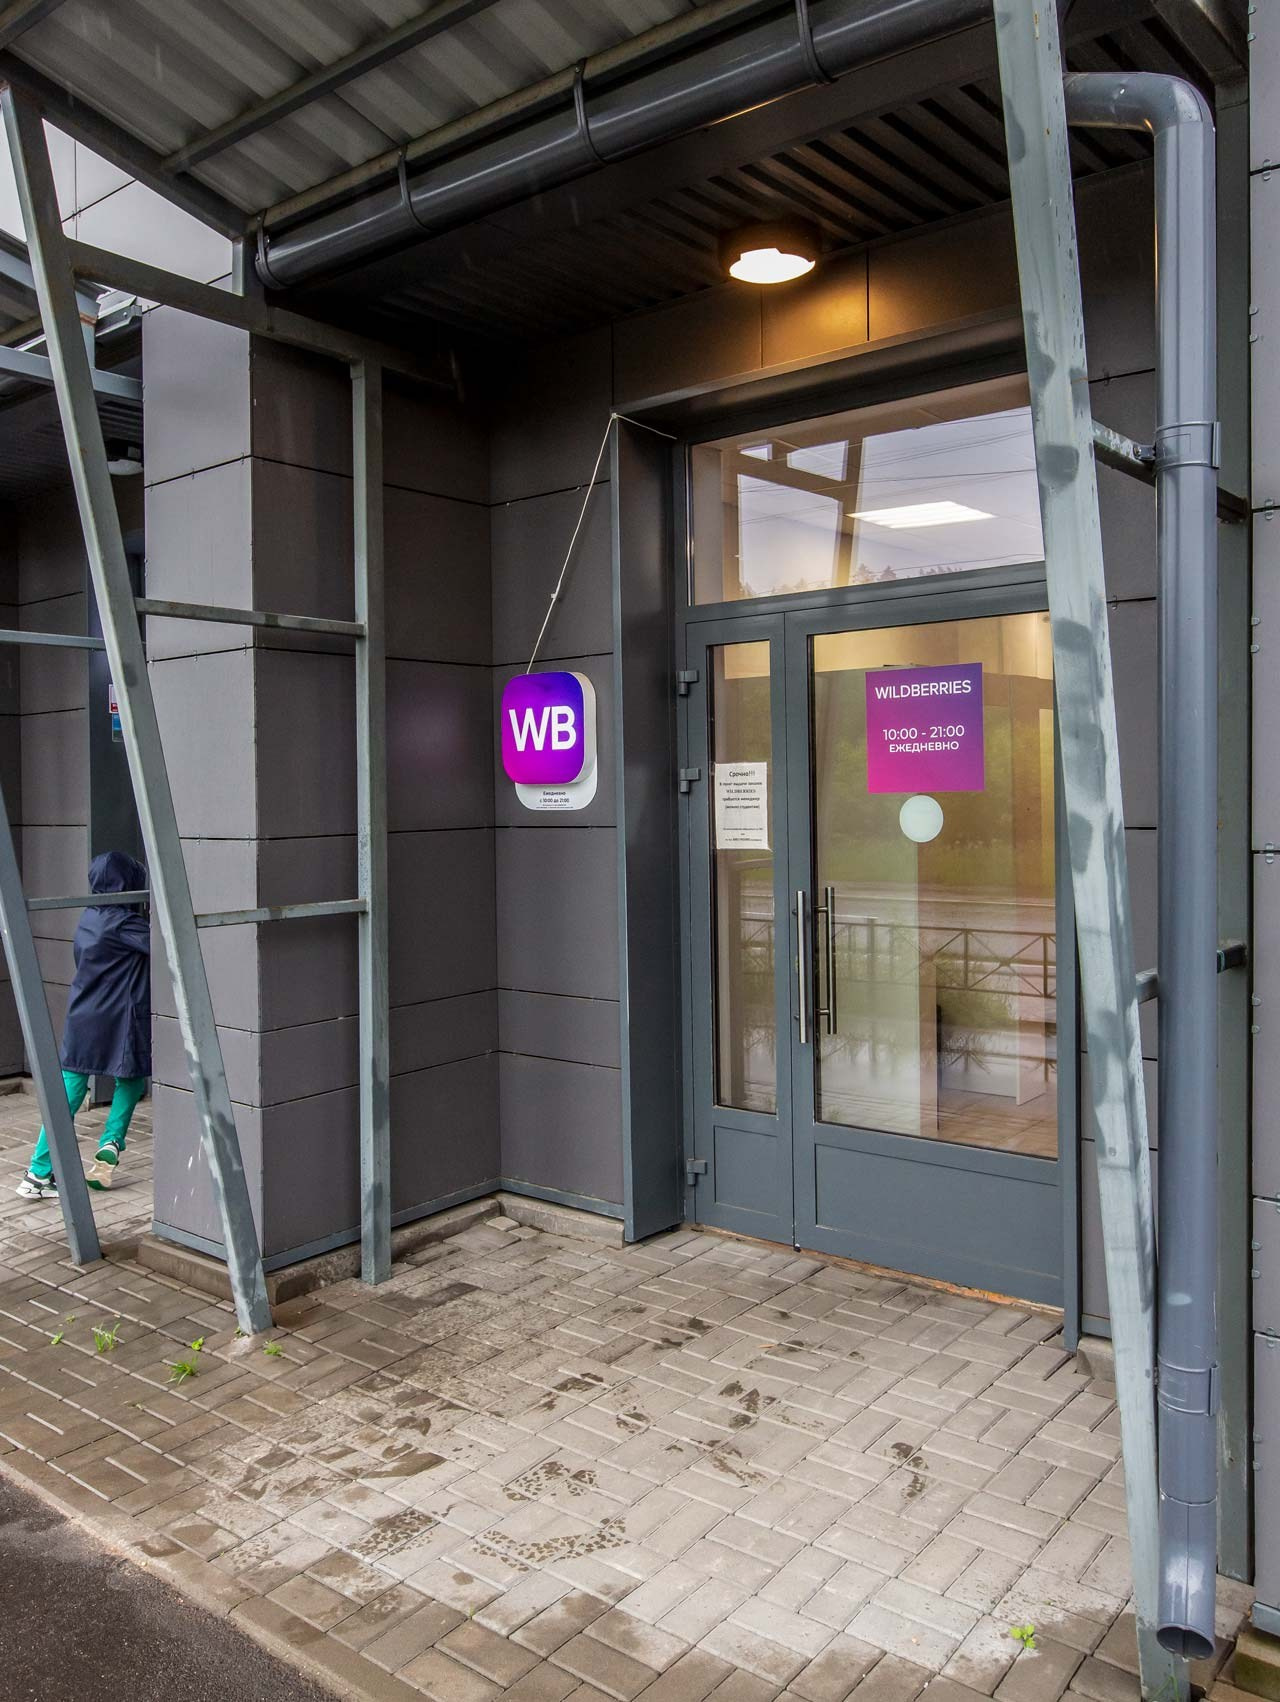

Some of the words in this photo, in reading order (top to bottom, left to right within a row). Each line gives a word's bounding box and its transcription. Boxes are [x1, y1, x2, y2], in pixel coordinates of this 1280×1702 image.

[874, 679, 972, 700] WILDBERRIES
[508, 705, 577, 752] WB
[883, 727, 918, 741] 10:00
[929, 725, 965, 738] 21:00
[889, 741, 960, 753] ЕЖЕДНЕВНО
